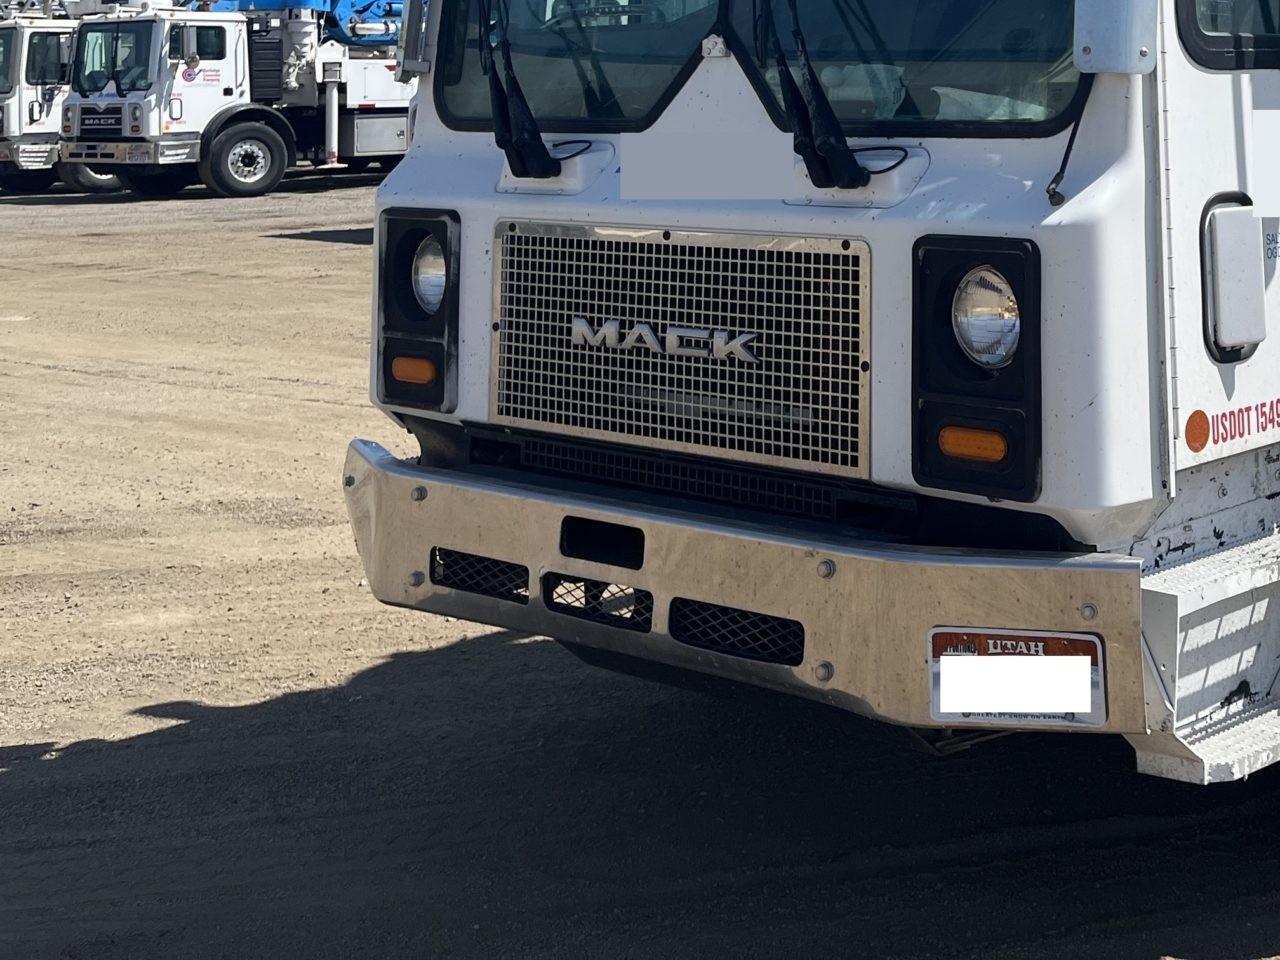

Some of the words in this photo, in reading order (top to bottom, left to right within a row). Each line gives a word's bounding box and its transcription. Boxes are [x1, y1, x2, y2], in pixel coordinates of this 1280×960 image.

[572, 316, 762, 364] MACK
[1211, 406, 1252, 445] USDOT
[987, 640, 1045, 656] UTAH
